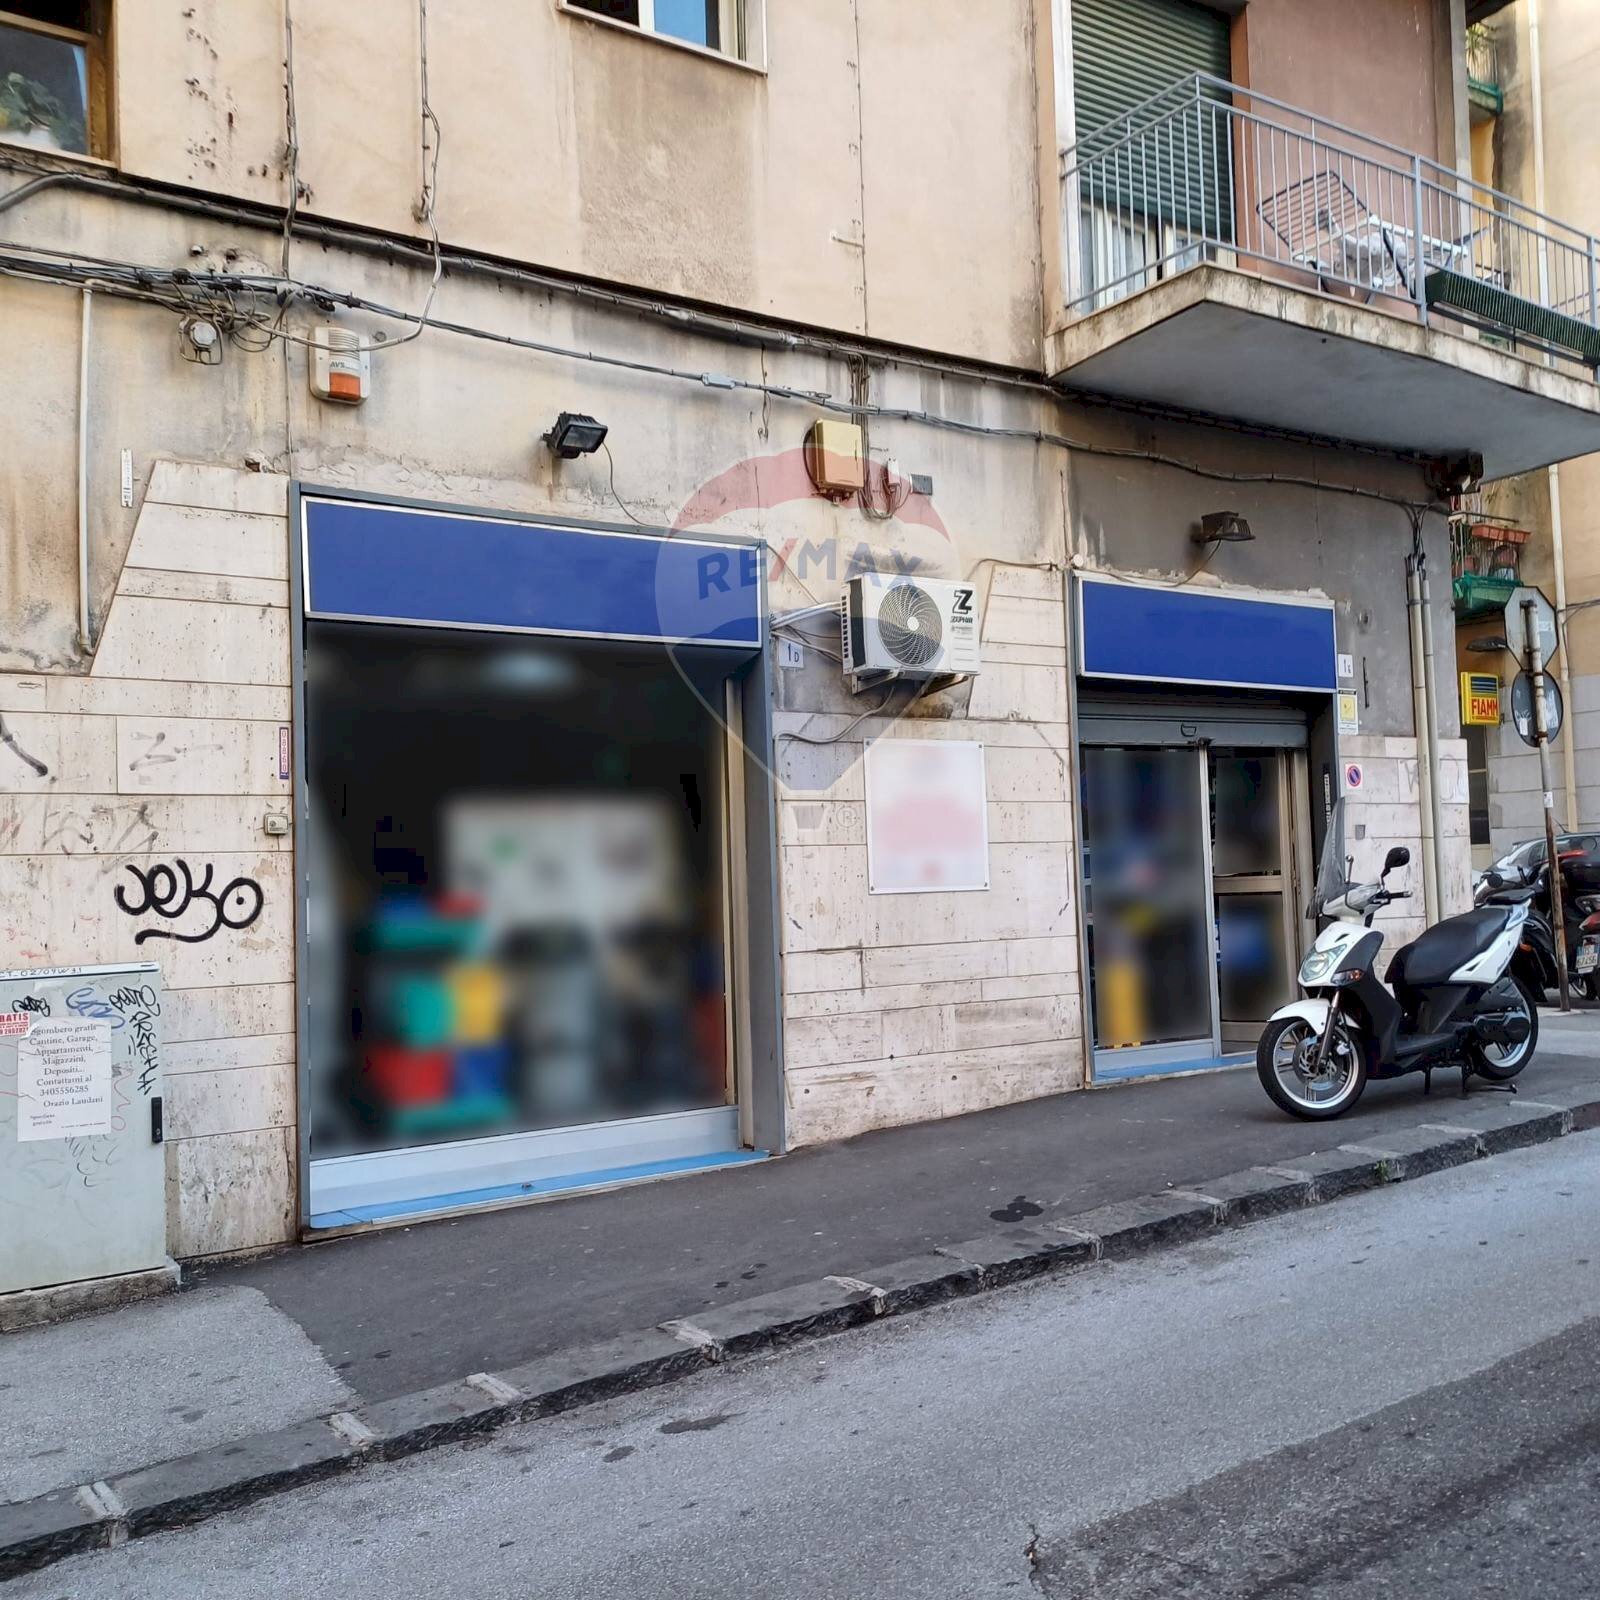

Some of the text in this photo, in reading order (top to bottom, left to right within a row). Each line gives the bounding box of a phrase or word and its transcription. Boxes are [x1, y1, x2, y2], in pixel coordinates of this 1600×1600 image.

[36, 1074, 92, 1086] Contattami al
[43, 1099, 70, 1108] Orazio
